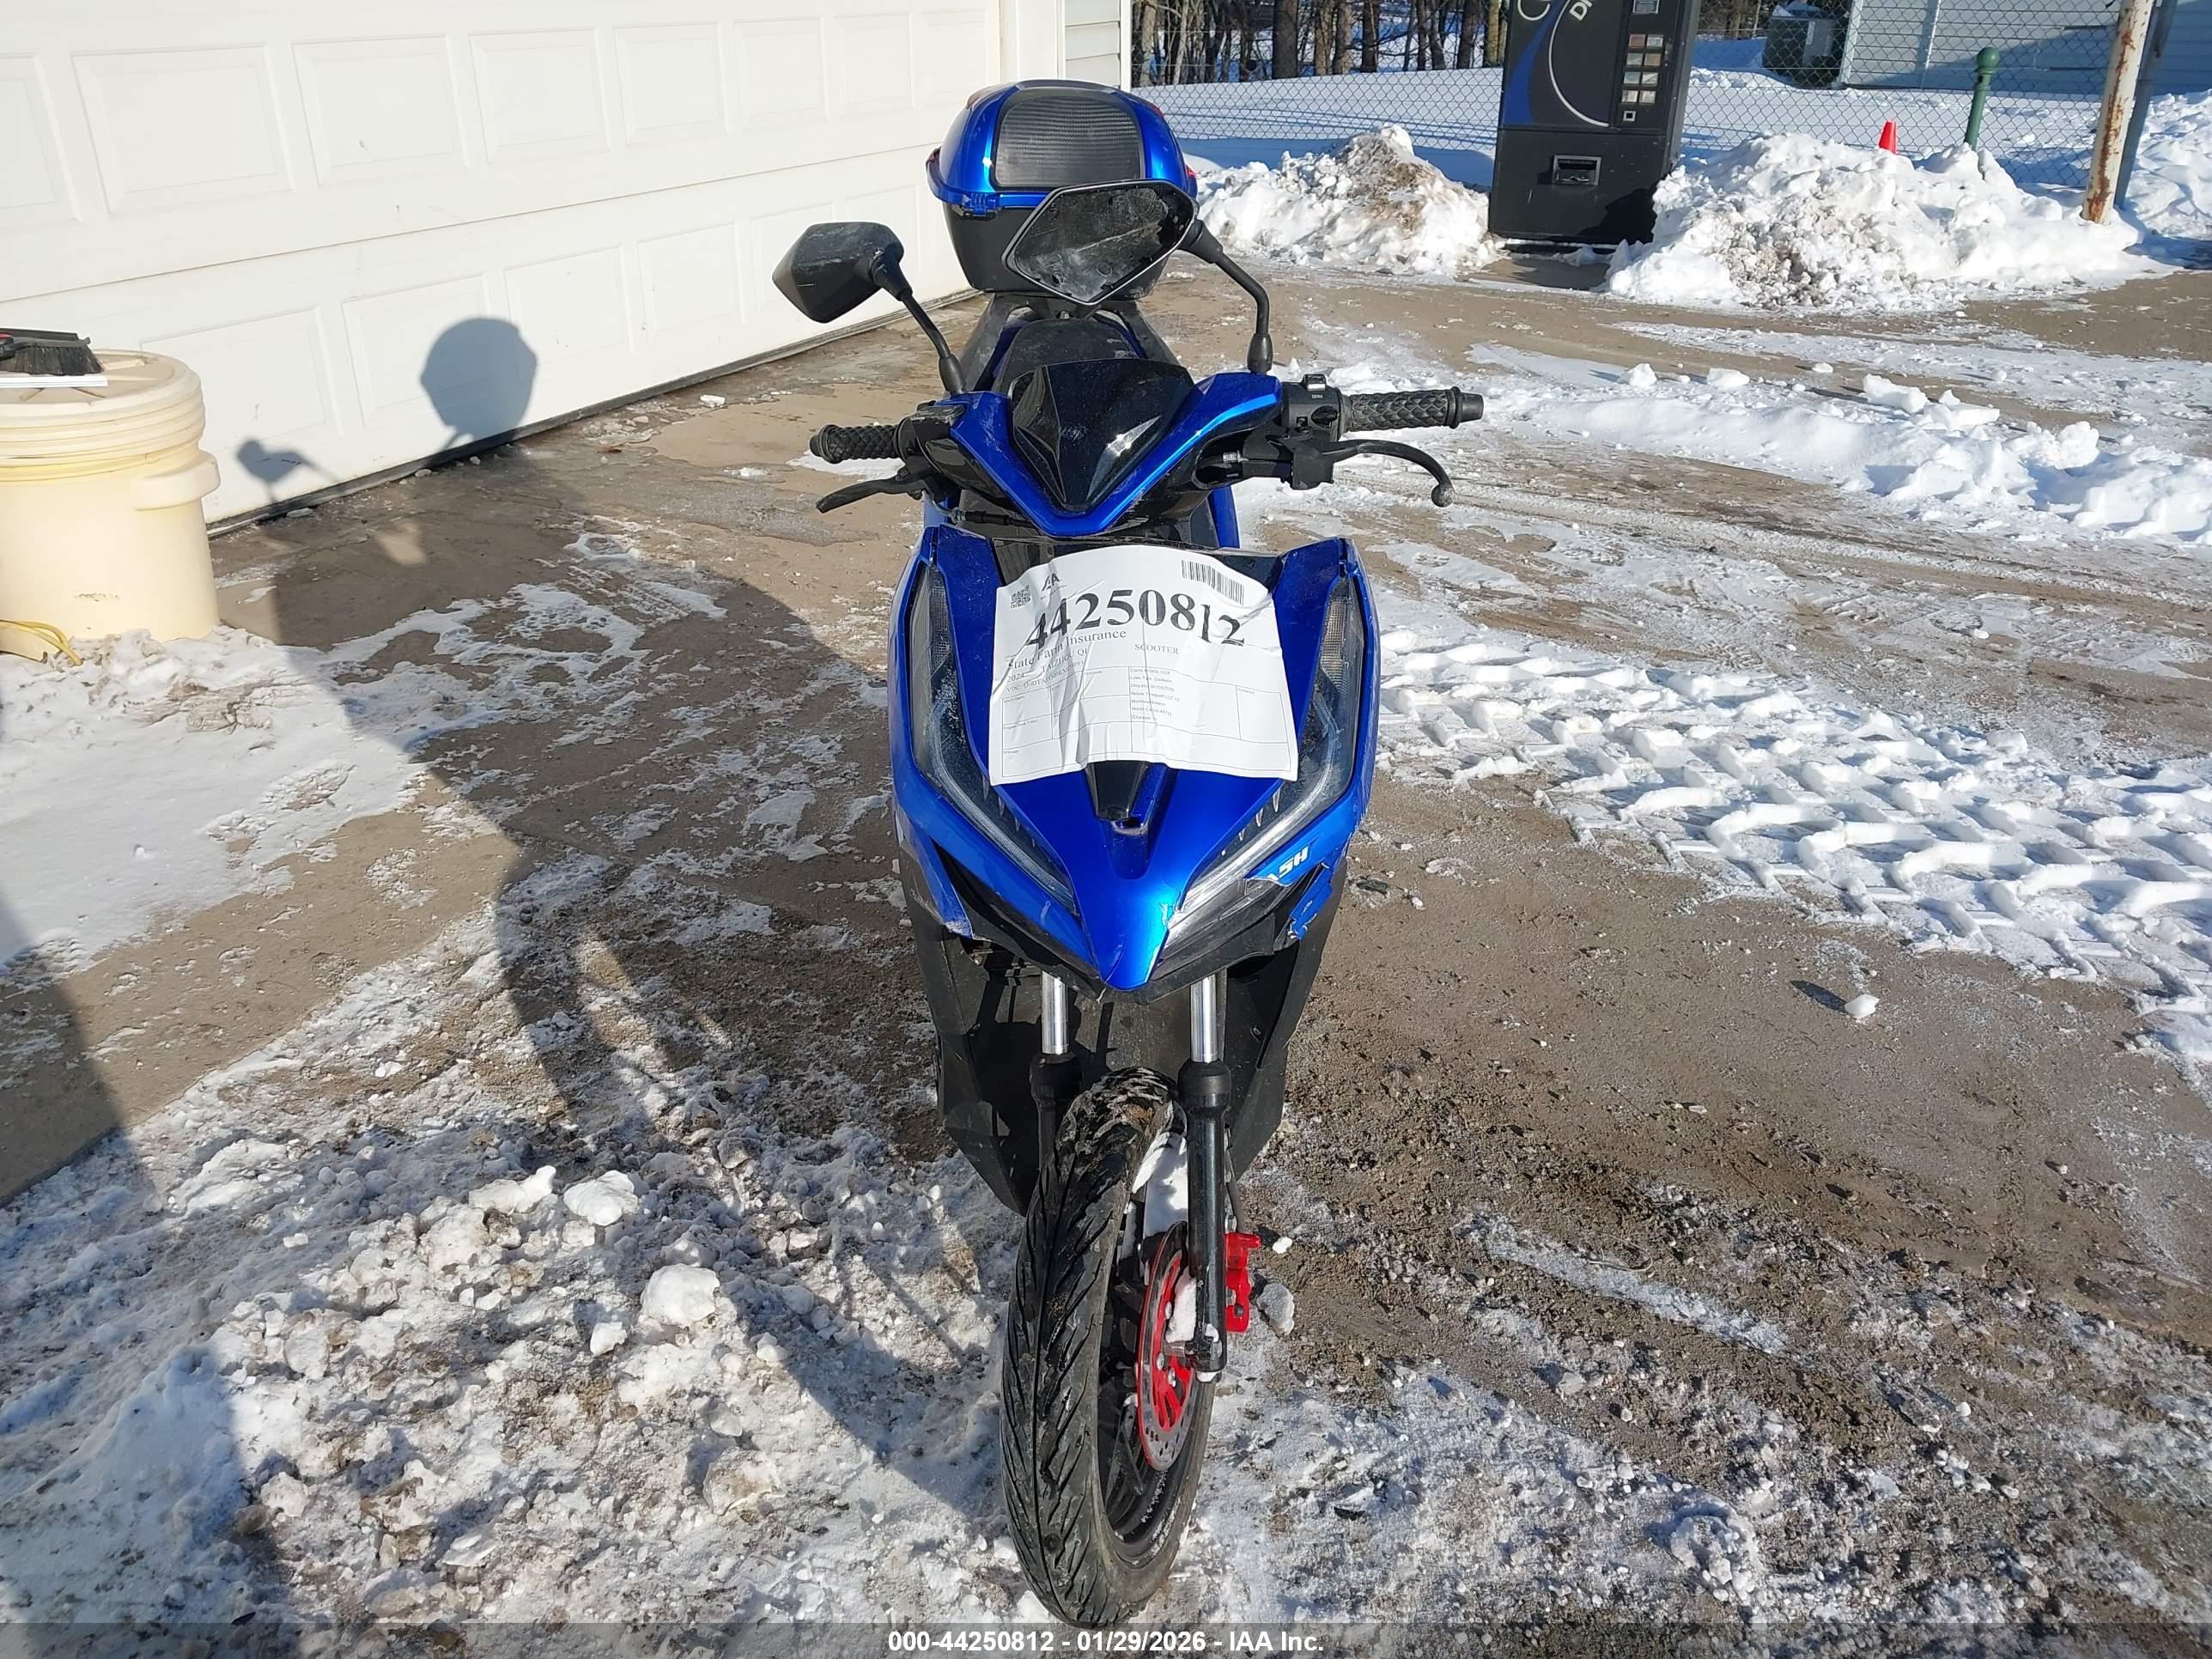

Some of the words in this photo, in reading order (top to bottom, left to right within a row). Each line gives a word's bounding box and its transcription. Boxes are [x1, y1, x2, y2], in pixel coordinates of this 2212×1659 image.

[1026, 589, 1245, 650] 44250812
[1066, 630, 1127, 645] Insurance
[1134, 643, 1179, 654] SCOOTER
